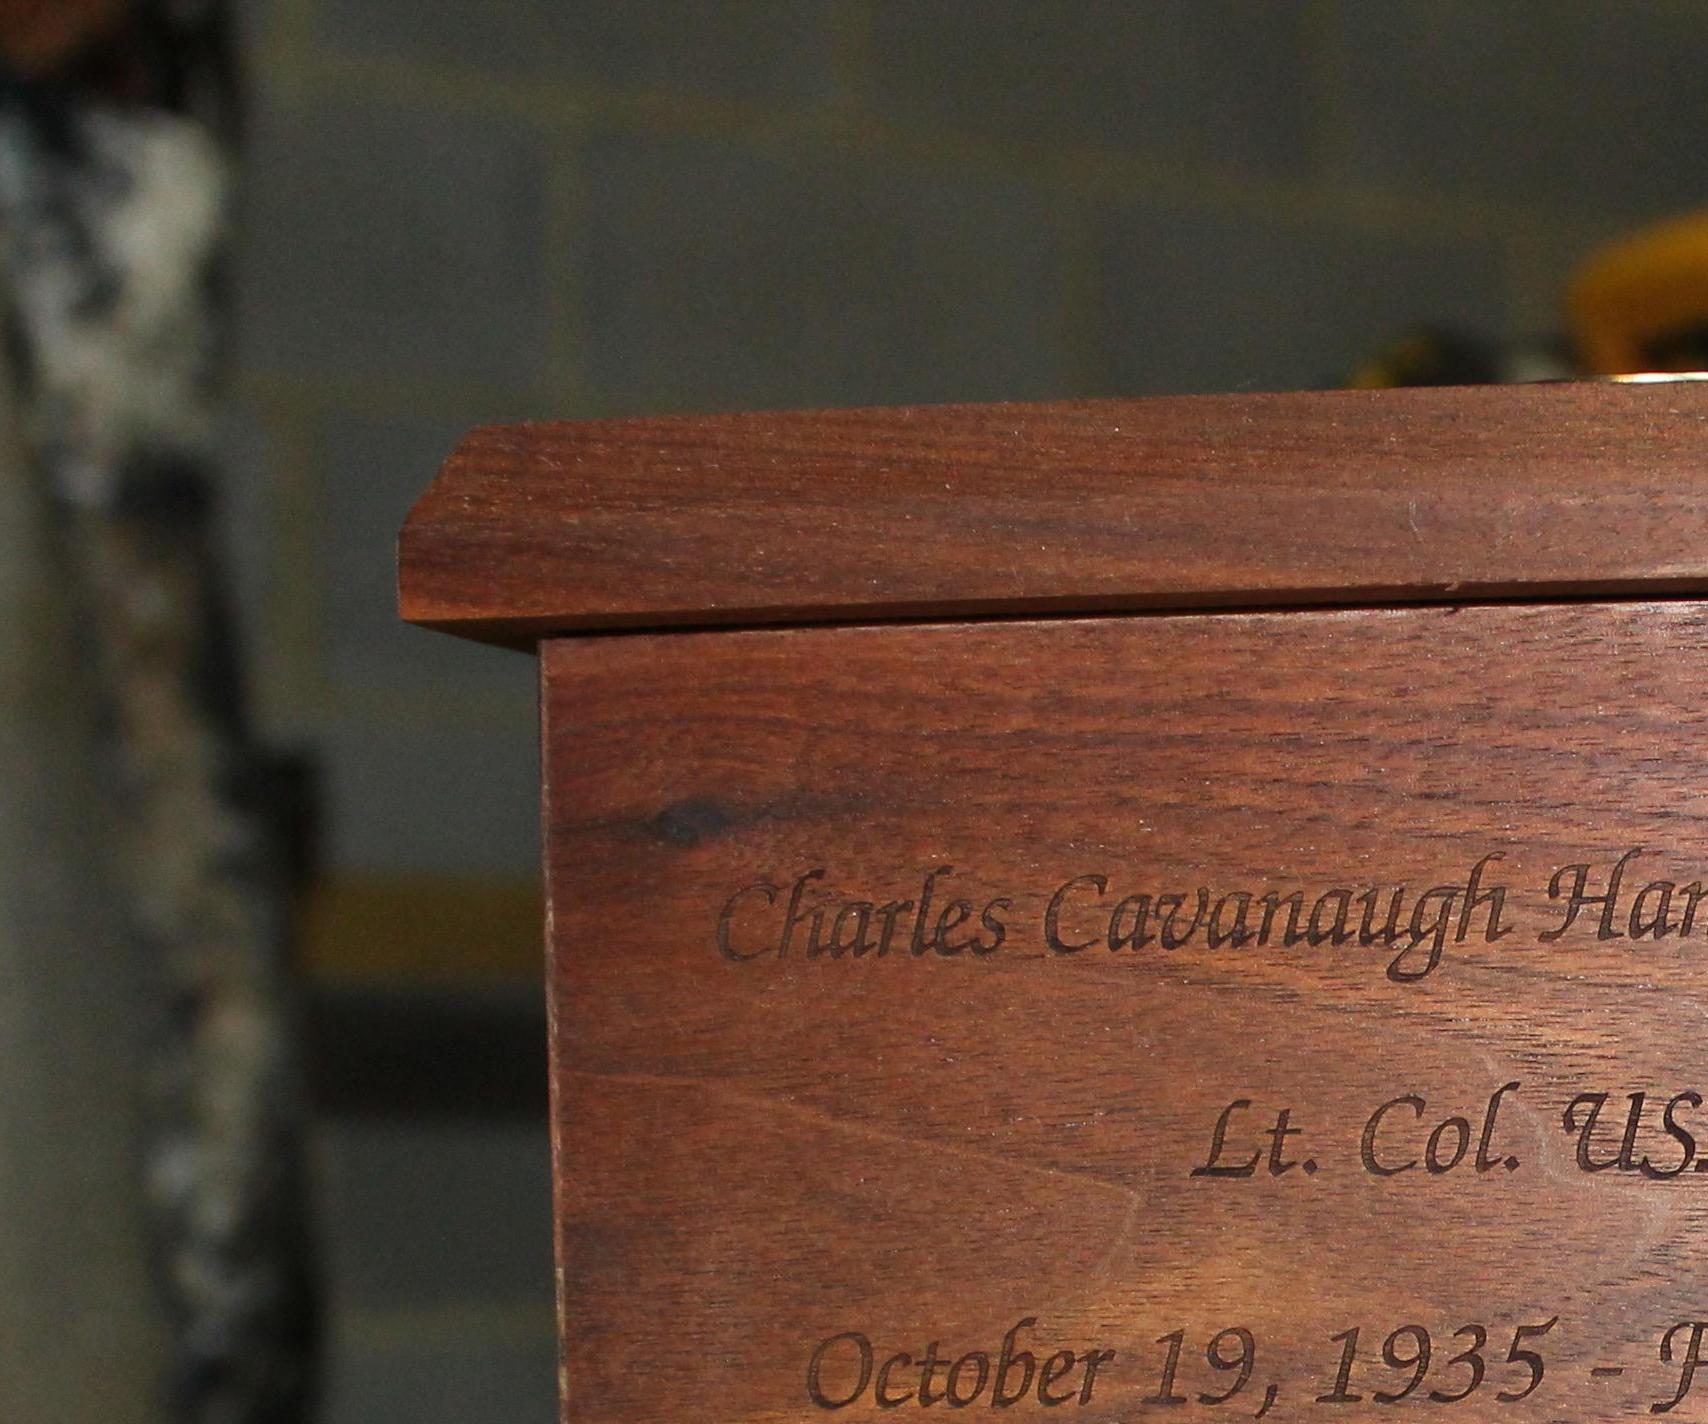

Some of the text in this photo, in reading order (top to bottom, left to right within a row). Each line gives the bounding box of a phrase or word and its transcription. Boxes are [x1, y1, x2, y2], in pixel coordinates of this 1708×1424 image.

[716, 863, 1012, 962] Charles
[1044, 850, 1511, 982] Cavanaugh
[1190, 1099, 1317, 1180] Lt.
[1360, 1082, 1521, 1178] Col.
[805, 1316, 1115, 1411] October
[1149, 1326, 1280, 1418] 19,
[1315, 1315, 1559, 1403] 1935
